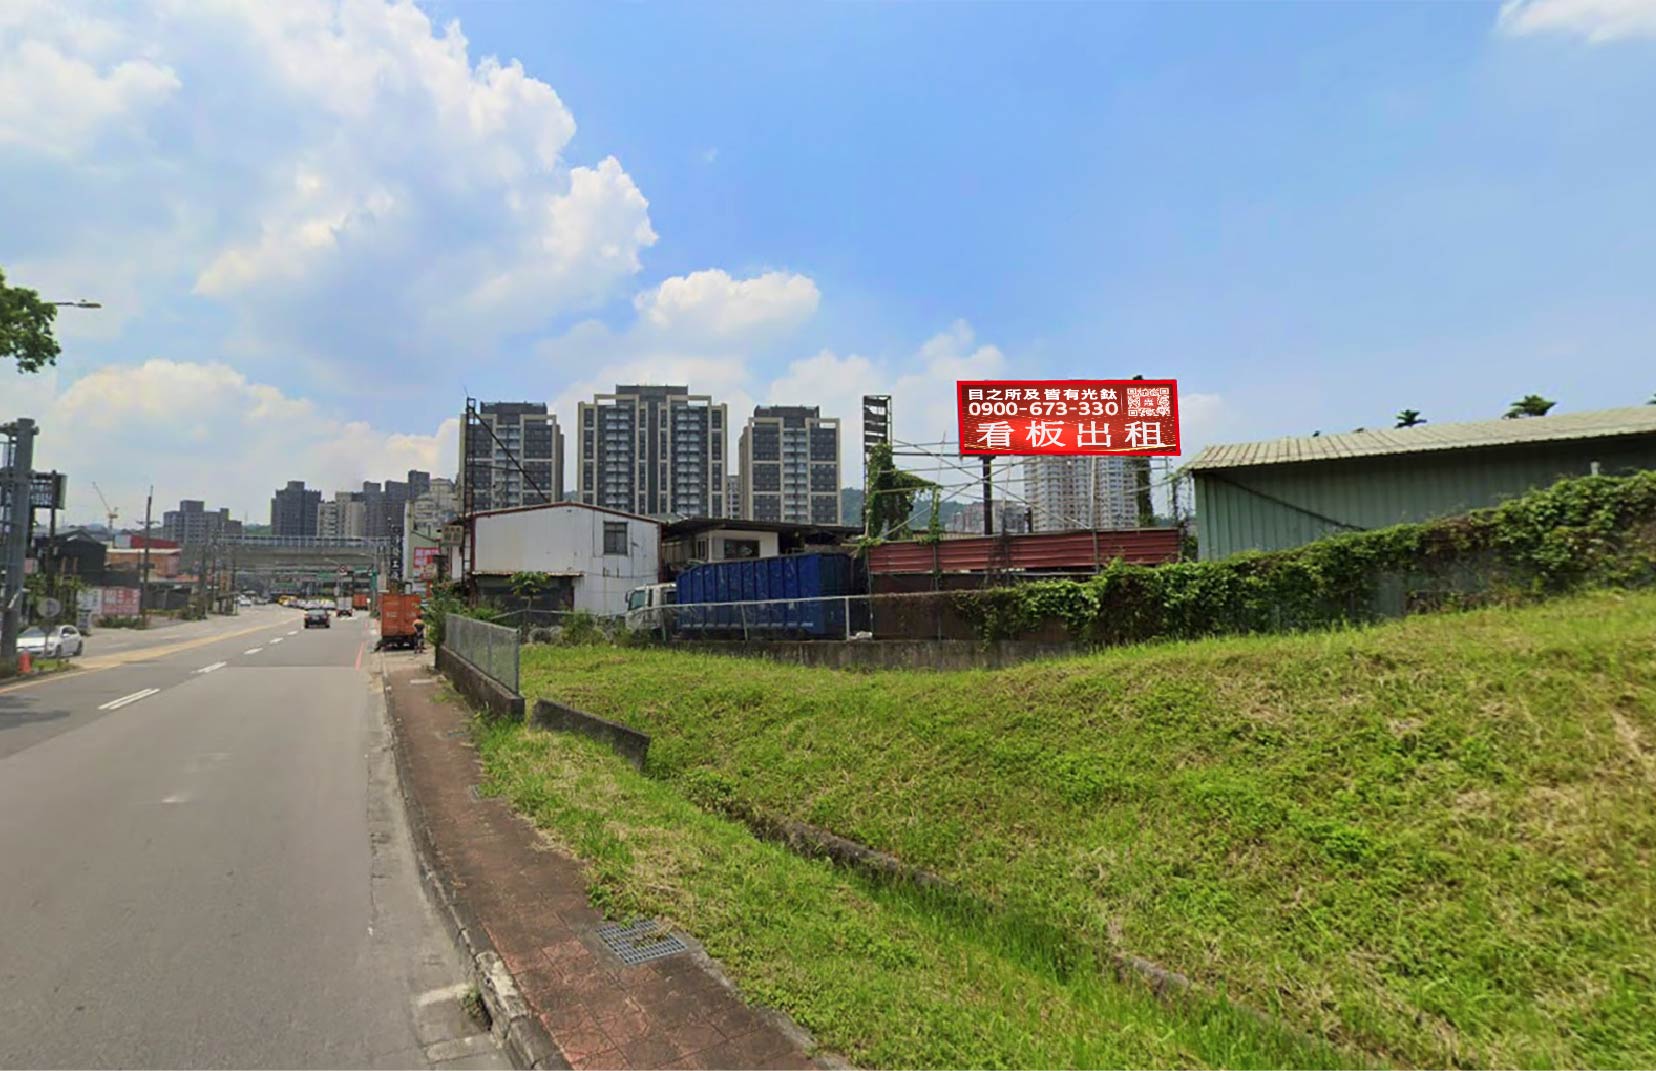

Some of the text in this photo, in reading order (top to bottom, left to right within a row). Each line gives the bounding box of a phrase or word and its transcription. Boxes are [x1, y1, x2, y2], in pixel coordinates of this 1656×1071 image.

[968, 388, 1117, 401] 目之所及皆有光鈦
[968, 402, 1118, 416] 0900-673-330
[976, 420, 1165, 448] 看板出租
